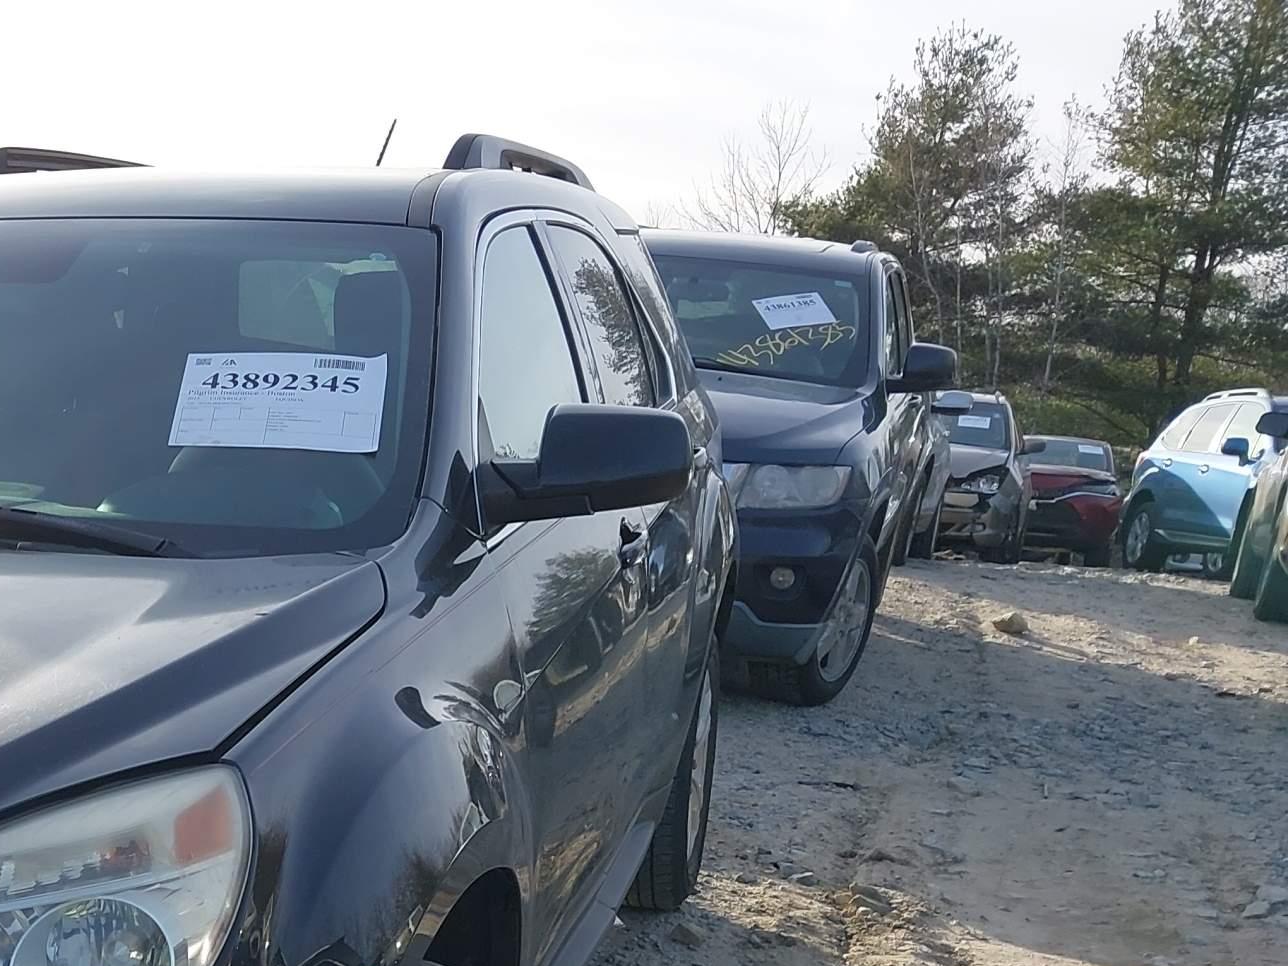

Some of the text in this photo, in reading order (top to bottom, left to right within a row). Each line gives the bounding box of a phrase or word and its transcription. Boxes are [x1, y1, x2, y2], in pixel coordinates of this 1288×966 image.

[764, 299, 817, 311] 43861385
[202, 372, 361, 394] 43892345
[220, 389, 259, 397] Insurance
